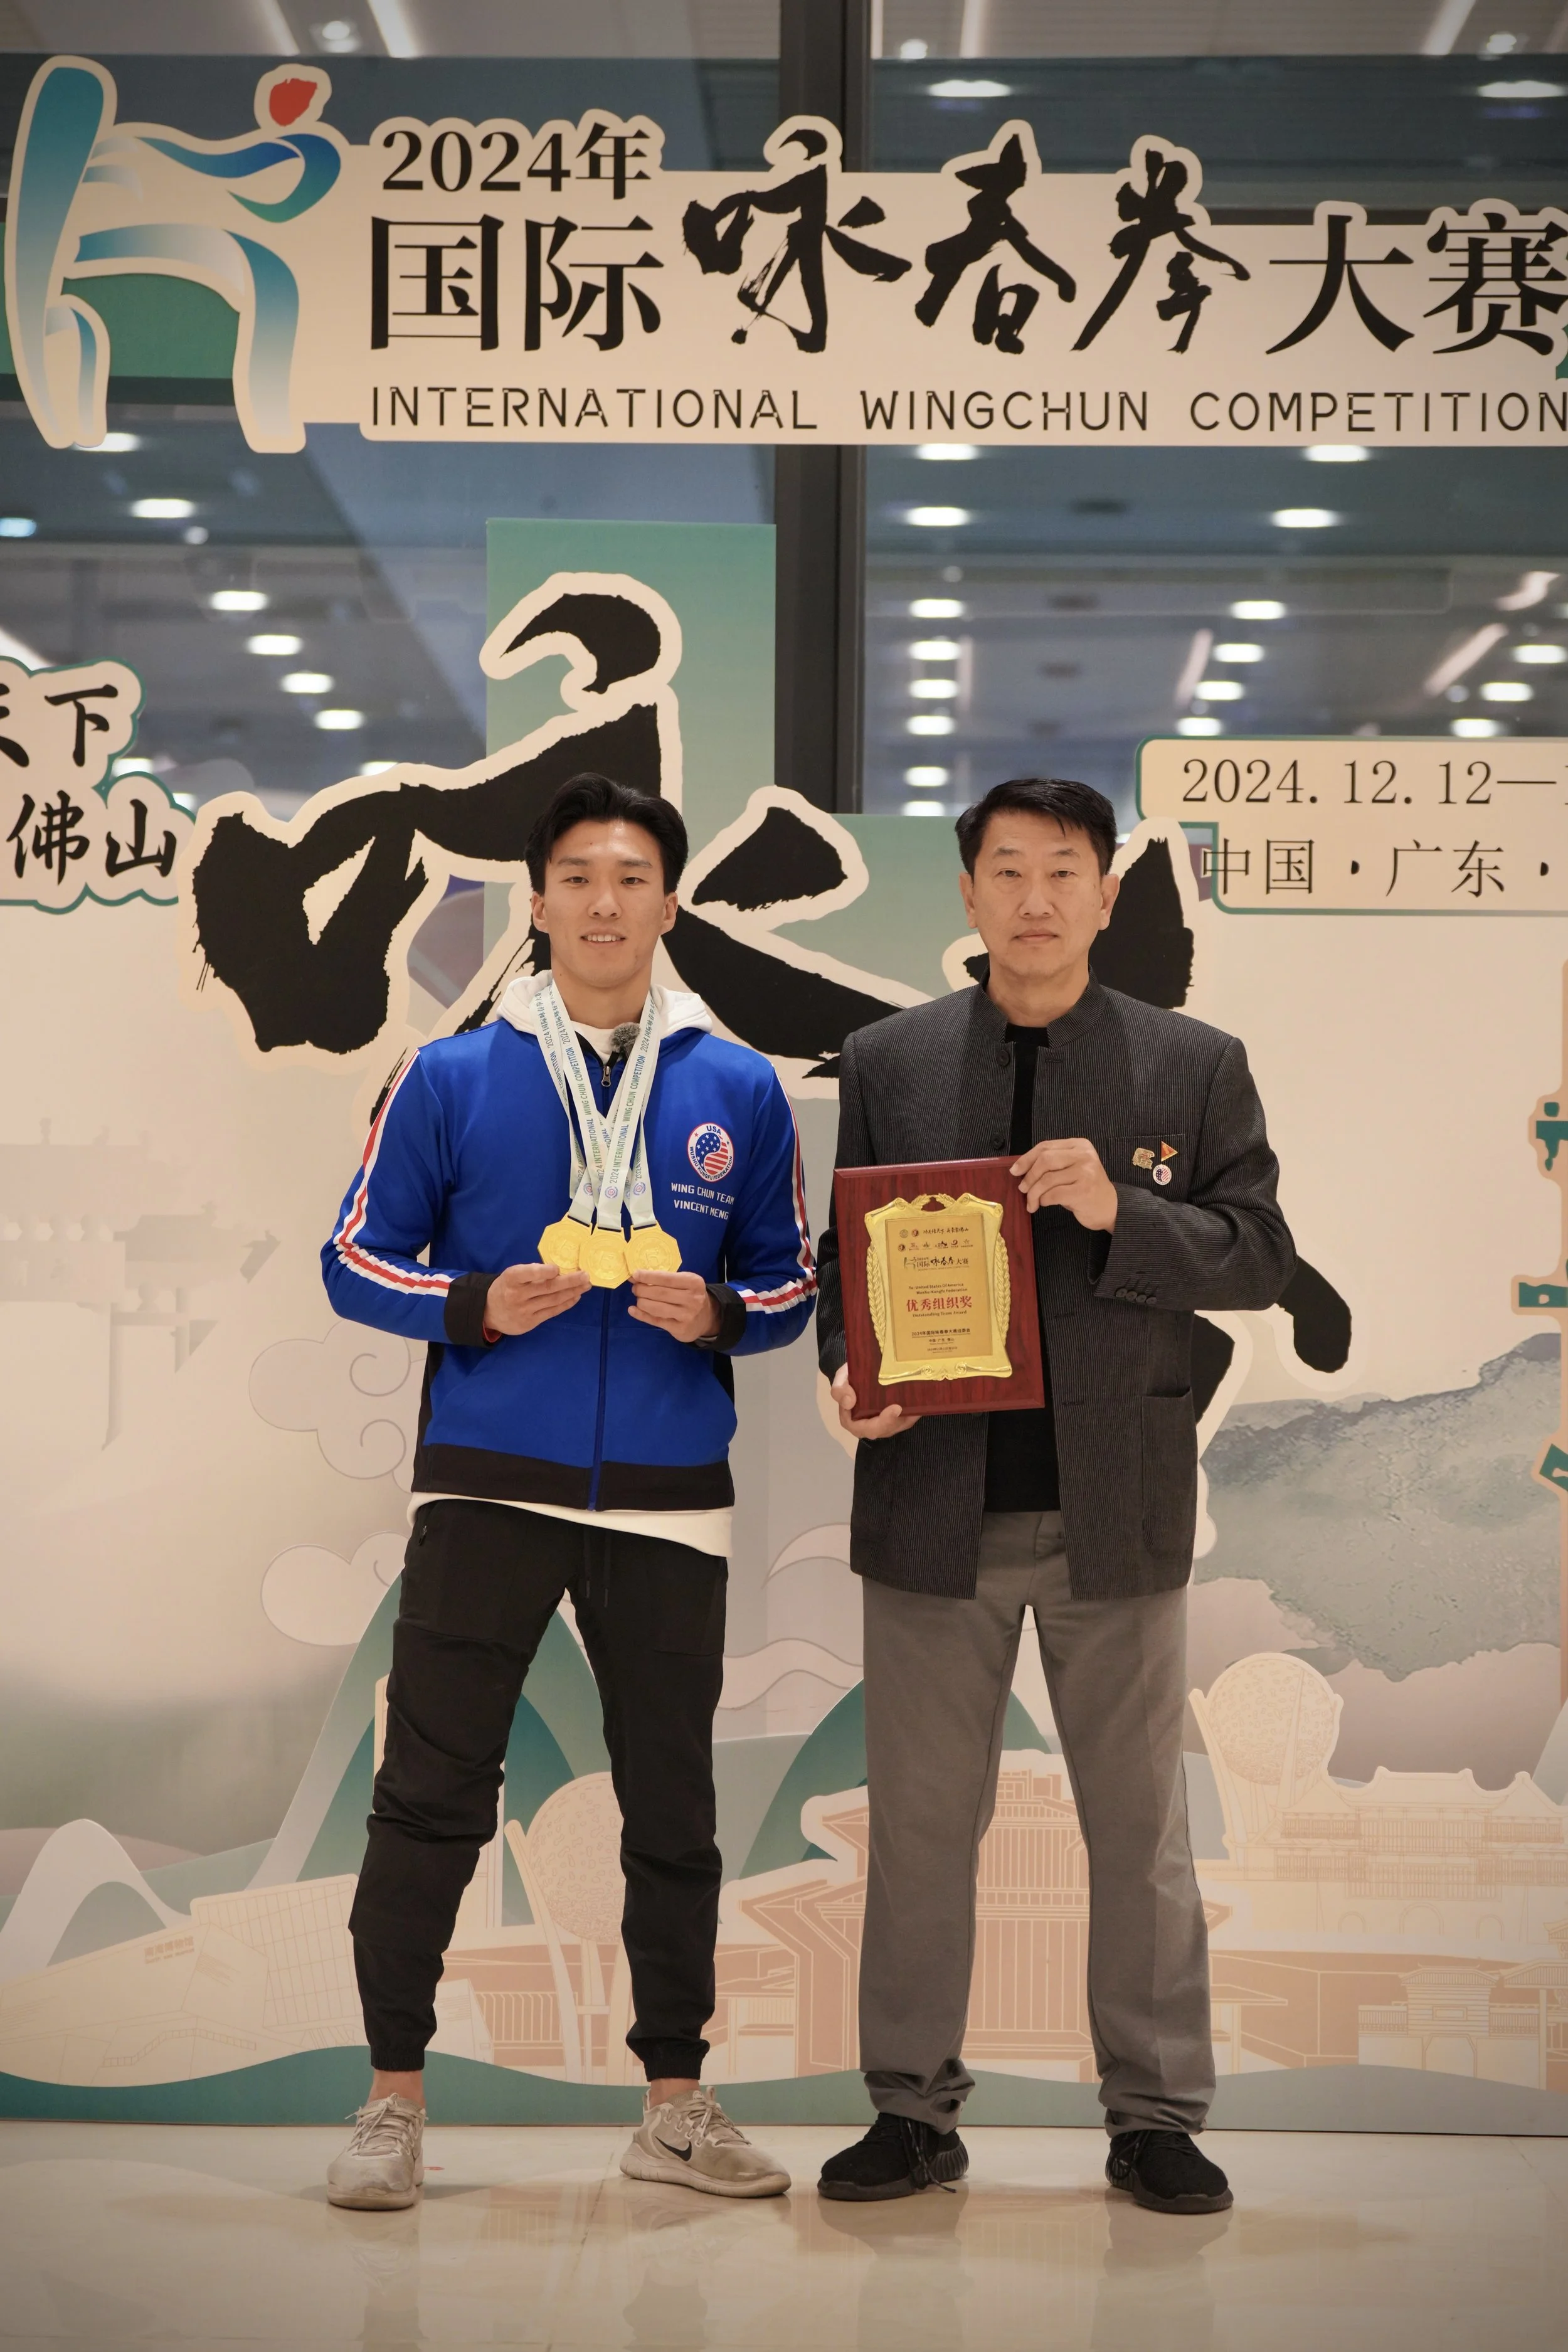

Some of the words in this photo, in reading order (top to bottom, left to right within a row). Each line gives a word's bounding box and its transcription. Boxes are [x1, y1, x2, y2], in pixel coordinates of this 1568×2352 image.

[382, 122, 651, 199] 2024年
[371, 129, 1568, 356] 国际咏春拳大赛
[373, 386, 817, 429] INTERNATIONAL
[861, 390, 1148, 432] WINGCHUN
[1190, 391, 1568, 433] COMPETITION
[6, 790, 177, 886] 佛山
[550, 1051, 563, 1089] COMPETITION
[566, 1047, 583, 1081] COMPETITION
[630, 1055, 646, 1089] COMPETITION
[578, 1083, 588, 1099] CHUN
[627, 1091, 637, 1107] CHUN
[582, 1101, 592, 1116] WING
[623, 1108, 633, 1122] WING
[586, 1119, 602, 1164] INTERNATIONAL
[613, 1125, 629, 1168] INTERNATIONAL
[706, 1125, 721, 1135] USA
[610, 1168, 620, 1184] 2024
[690, 1147, 699, 1167] WUSHU
[697, 1167, 713, 1180] KUNGFU
[713, 1156, 733, 1180] FEDERATION
[671, 1182, 695, 1194] WING
[697, 1187, 715, 1199] CHUN
[716, 1192, 734, 1205] TEAM
[674, 1199, 709, 1214] VINCENT
[709, 1207, 729, 1220] MENG
[906, 1295, 972, 1312] 优秀组织奖
